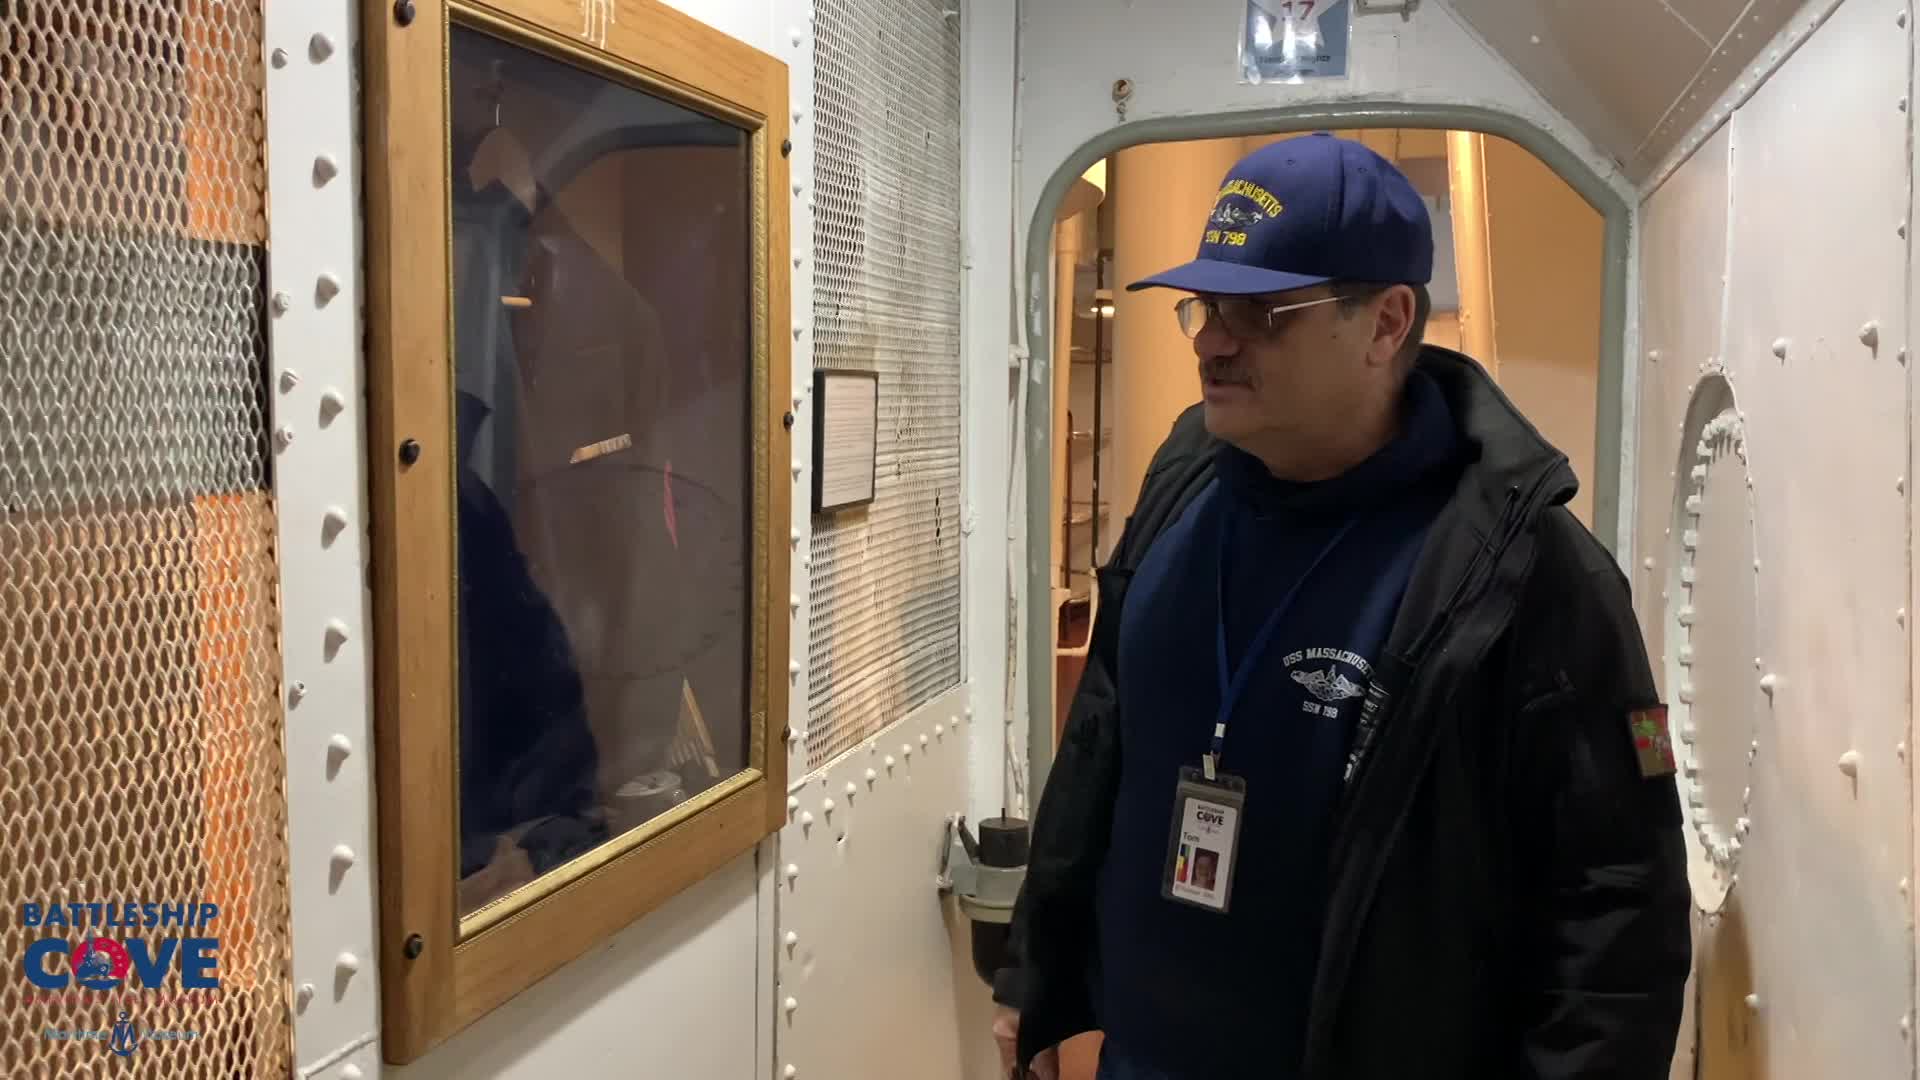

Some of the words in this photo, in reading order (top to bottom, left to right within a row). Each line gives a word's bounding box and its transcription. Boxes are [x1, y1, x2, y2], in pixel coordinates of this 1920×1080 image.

[1281, 0, 1316, 20] 17
[1221, 231, 1247, 246] 798
[1283, 651, 1303, 667] USS
[1302, 701, 1321, 714] SSN
[1196, 811, 1225, 826] COVE
[1183, 831, 1200, 843] Tom
